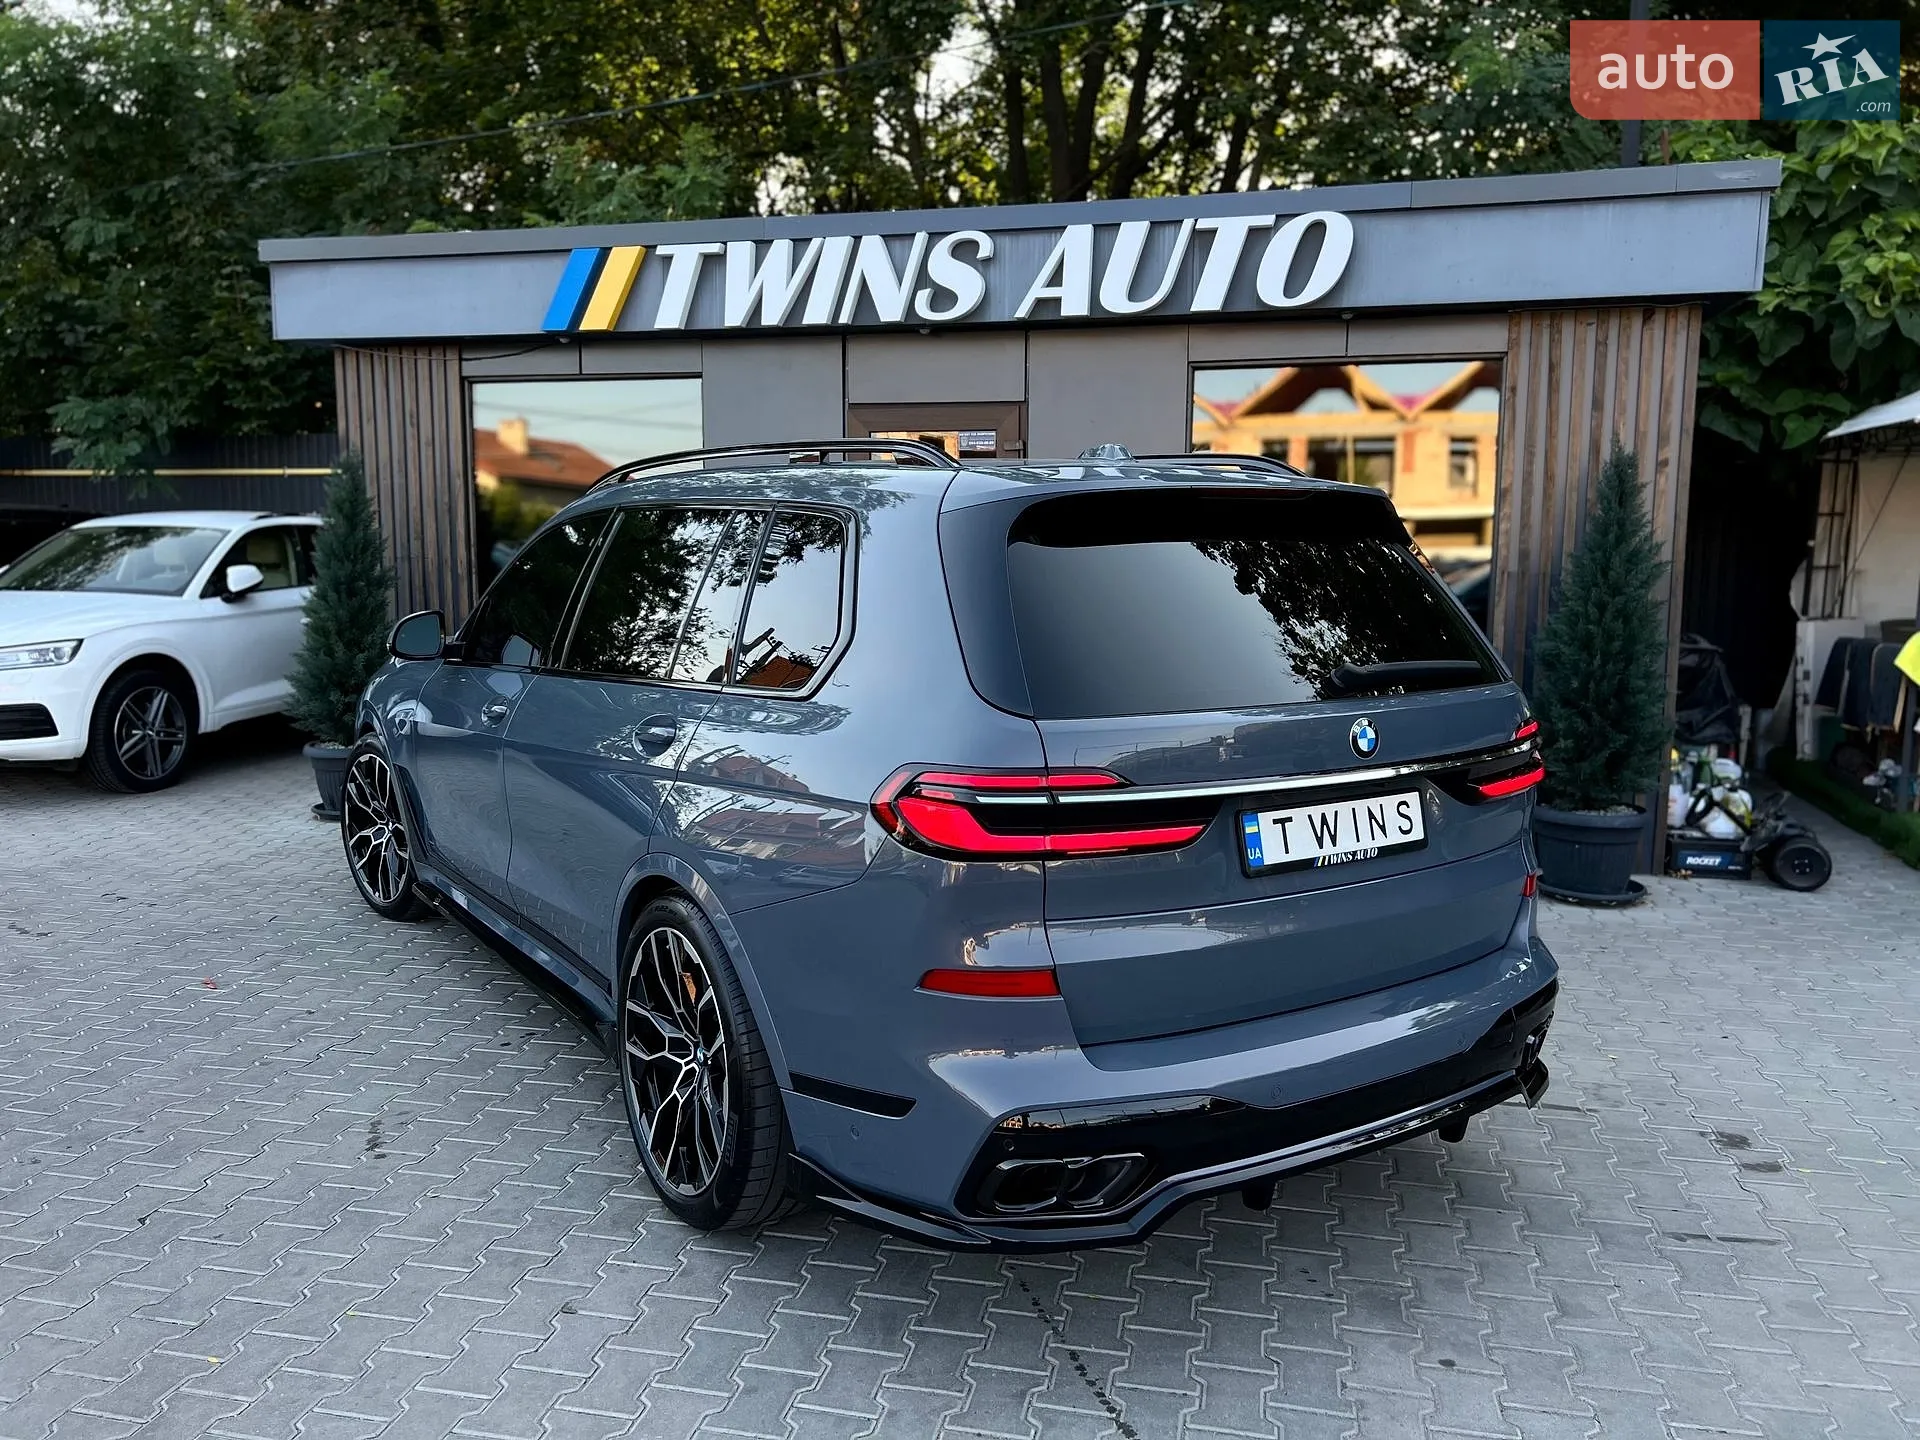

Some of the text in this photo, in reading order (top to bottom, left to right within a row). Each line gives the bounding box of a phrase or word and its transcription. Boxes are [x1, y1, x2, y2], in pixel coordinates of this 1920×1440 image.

[653, 210, 1355, 330] TWINS AUTO
[1272, 800, 1414, 855] TWINS
[1248, 848, 1262, 860] UA
[1324, 847, 1378, 866] TWINS AUTO
